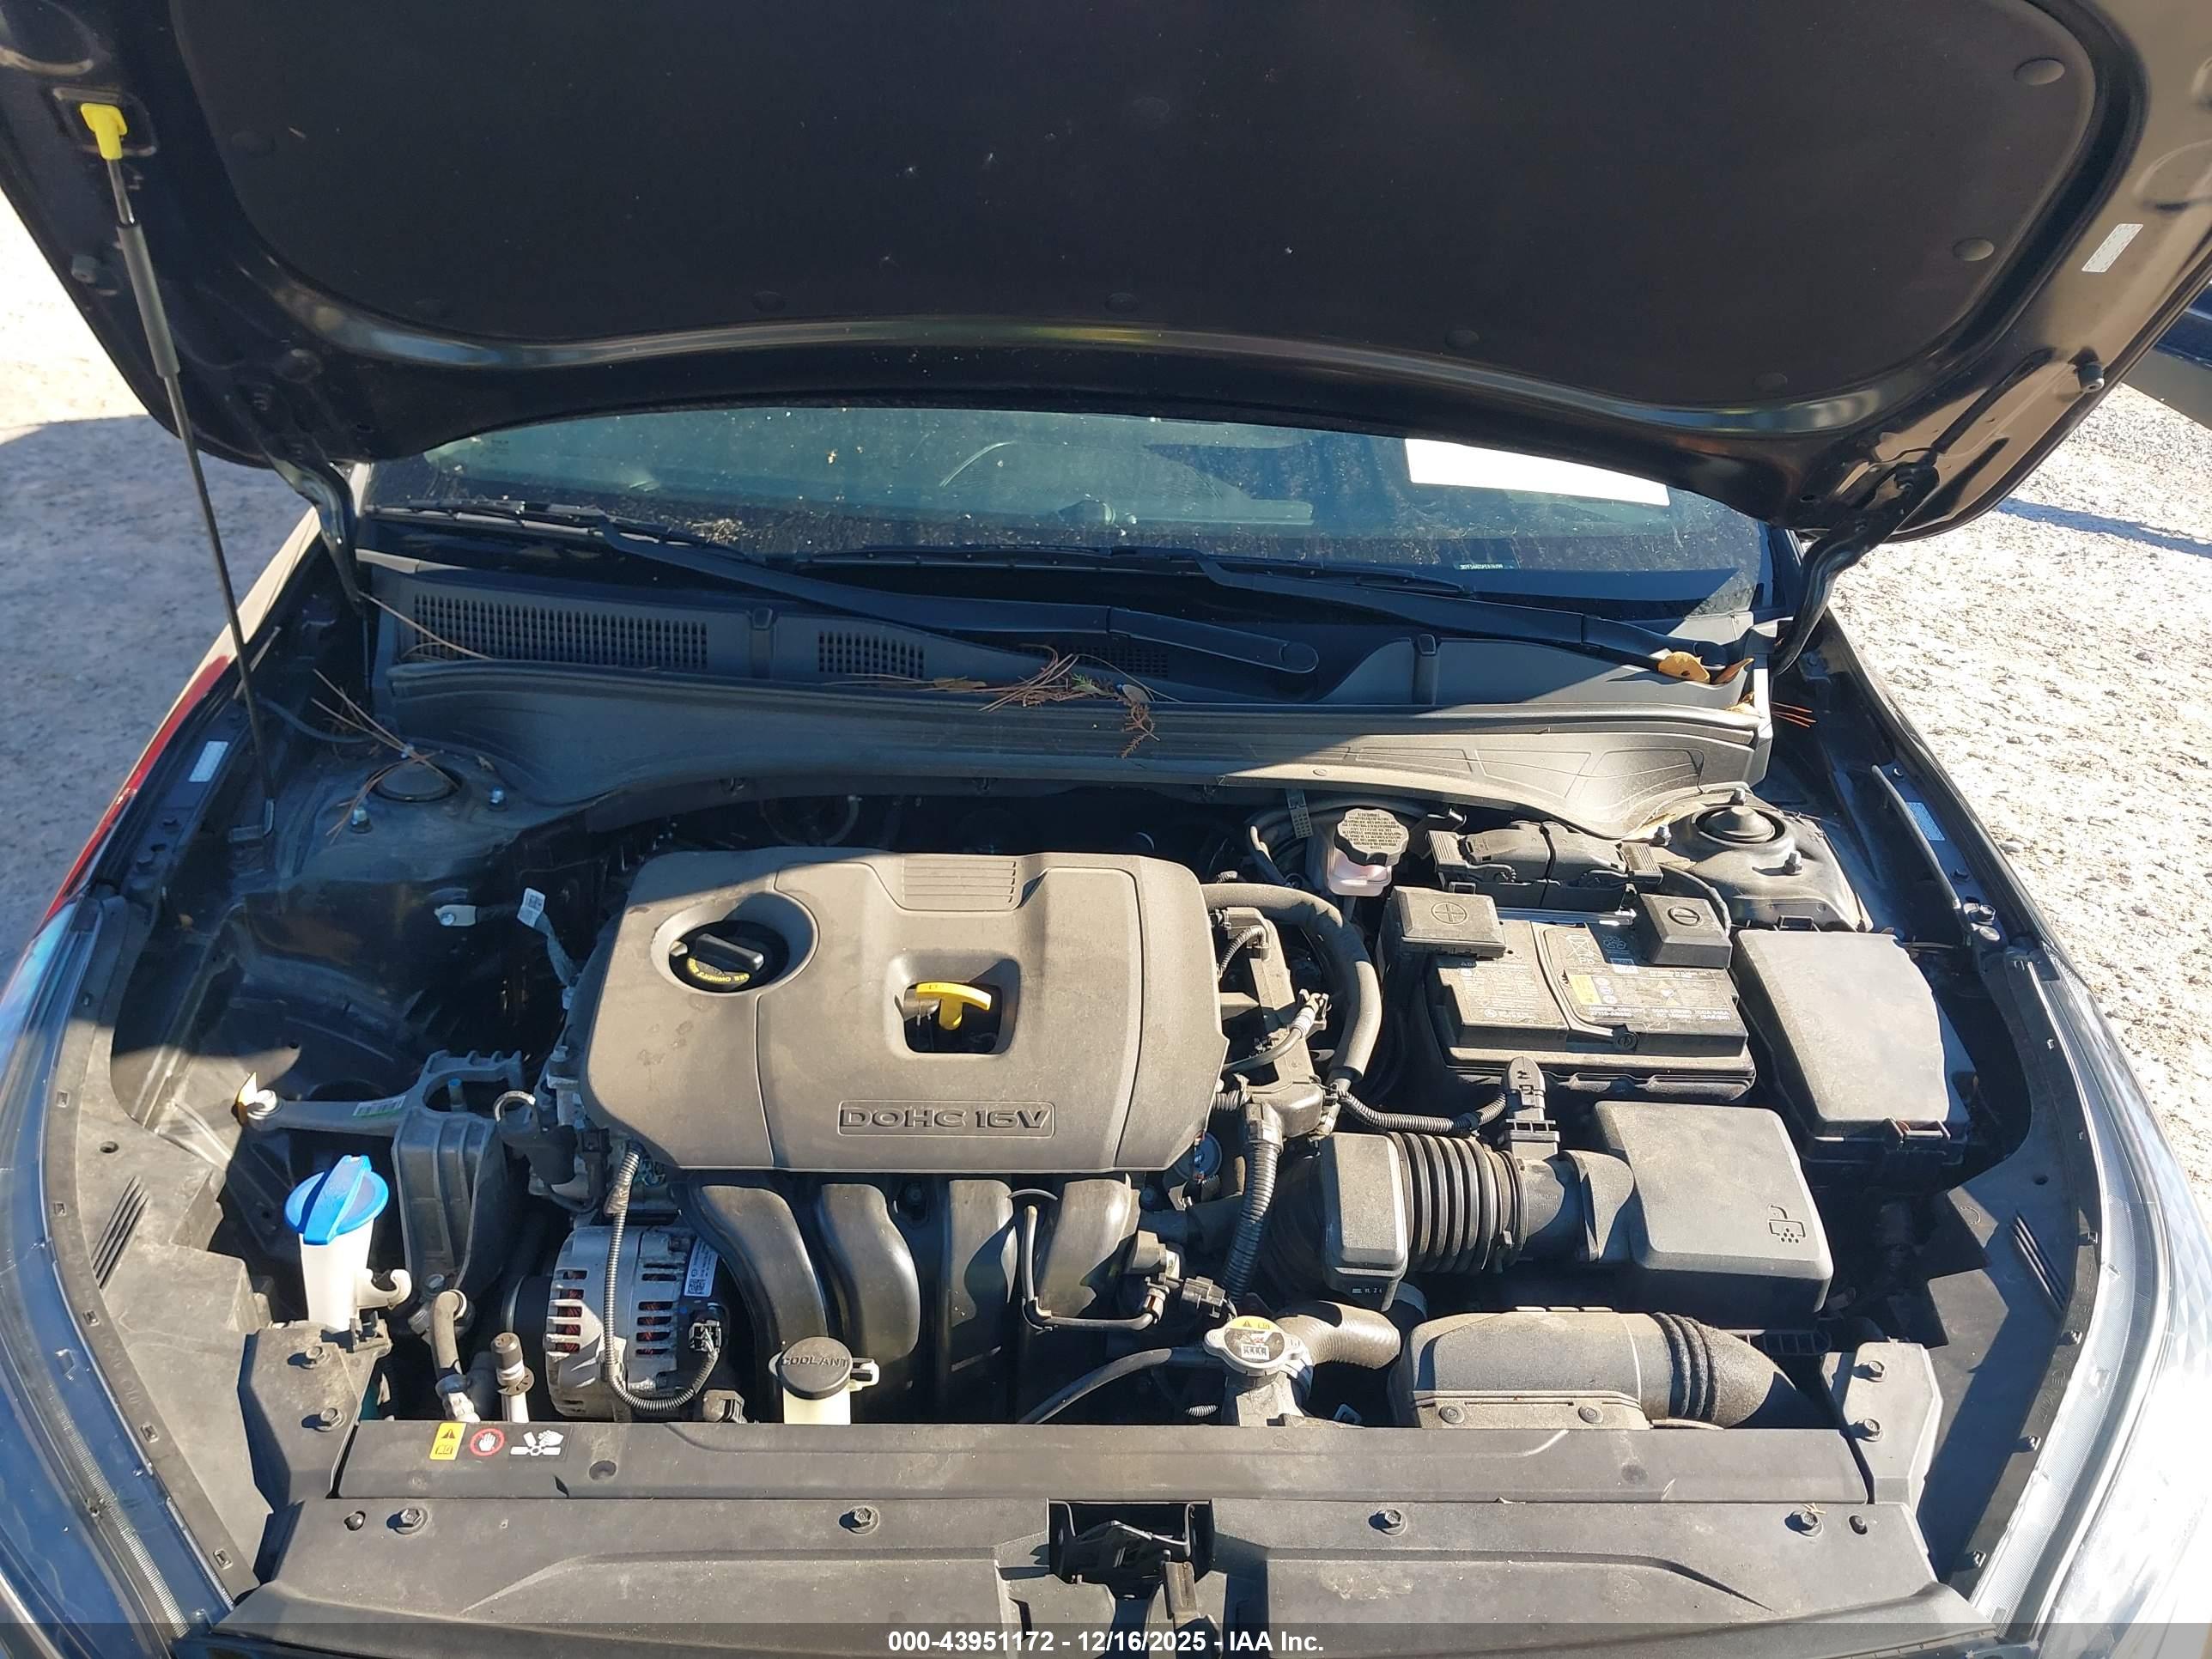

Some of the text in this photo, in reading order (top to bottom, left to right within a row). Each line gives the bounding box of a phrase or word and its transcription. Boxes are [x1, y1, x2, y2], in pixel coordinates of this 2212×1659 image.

[839, 1106, 1051, 1130] DOHC 16V
[781, 1356, 849, 1368] COOLANT
